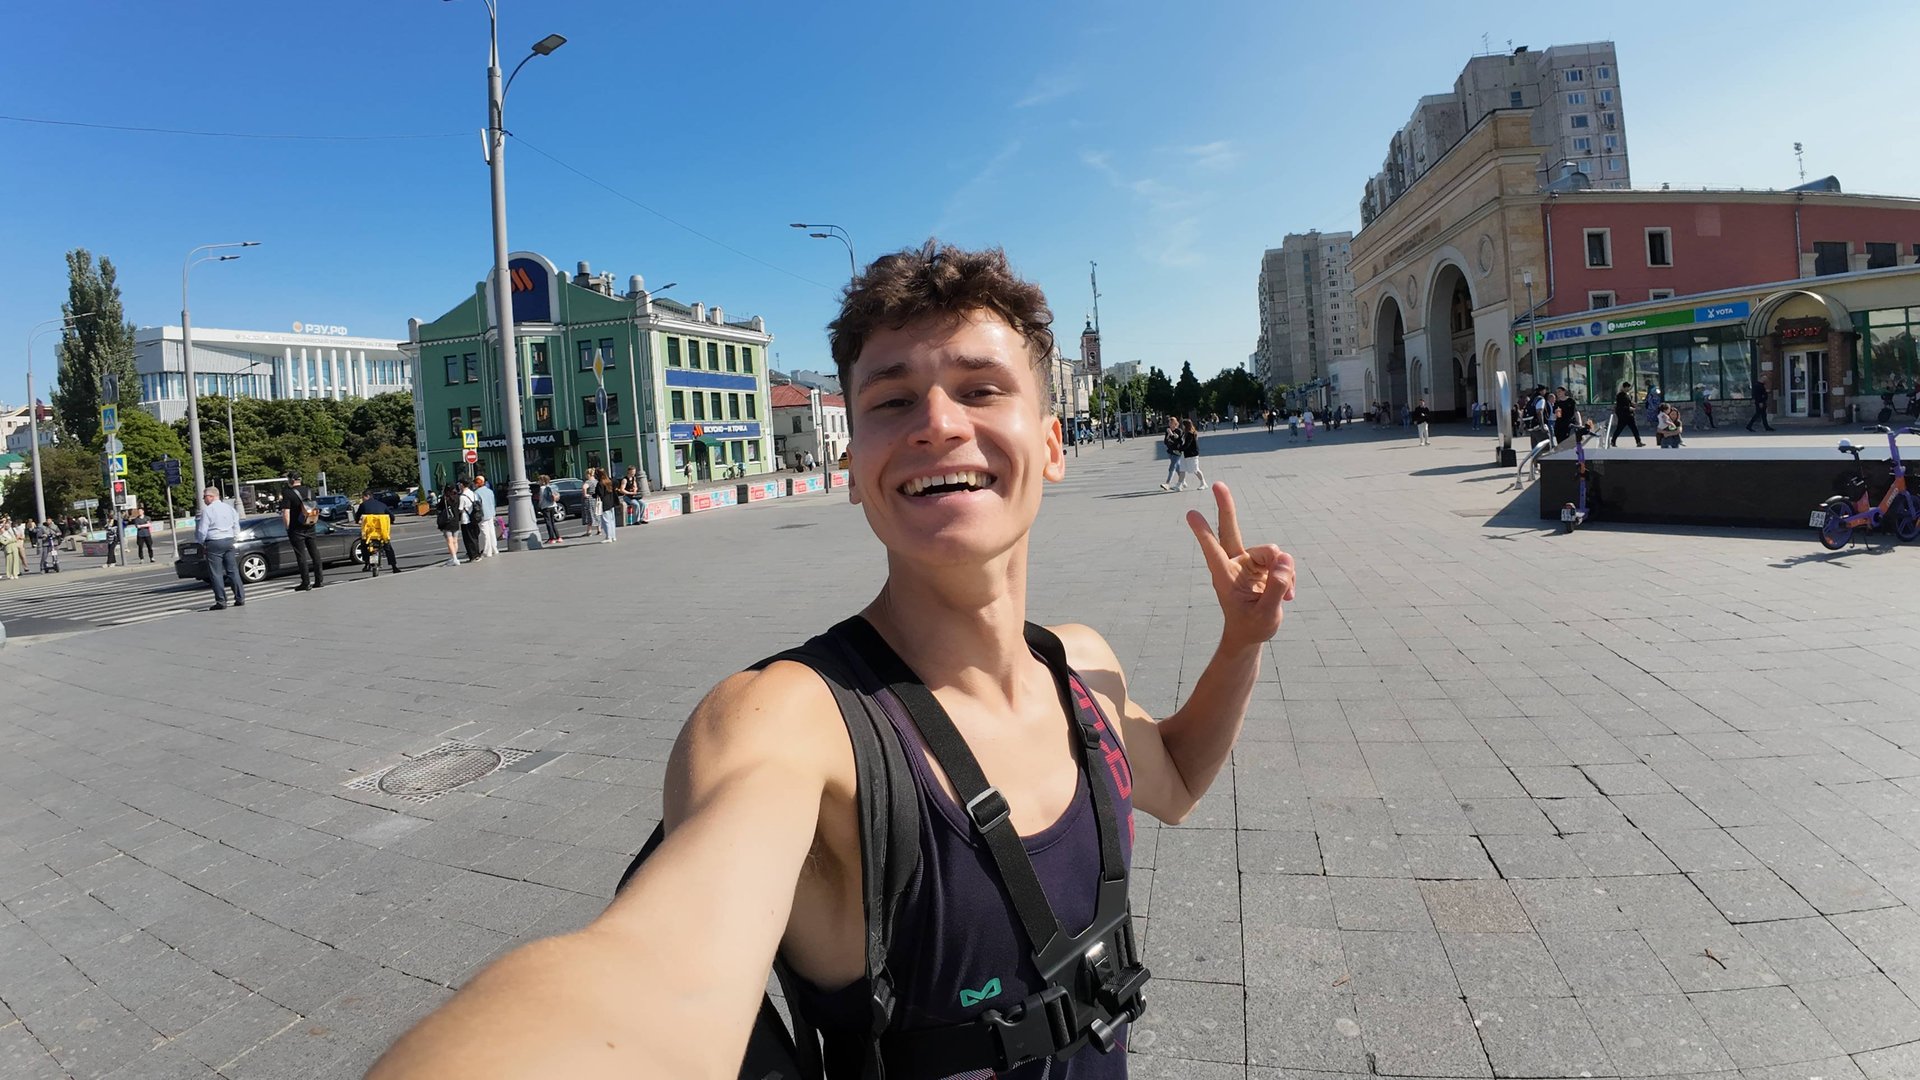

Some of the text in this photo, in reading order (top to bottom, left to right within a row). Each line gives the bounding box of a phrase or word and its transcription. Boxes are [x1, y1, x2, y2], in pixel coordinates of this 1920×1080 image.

[1716, 308, 1734, 316] YOTA
[305, 323, 348, 336] РЭУ.РФ
[1615, 320, 1646, 329] МЕГАФОН
[1546, 326, 1585, 341] АПТЕКА
[526, 434, 555, 445] ТОЧКА
